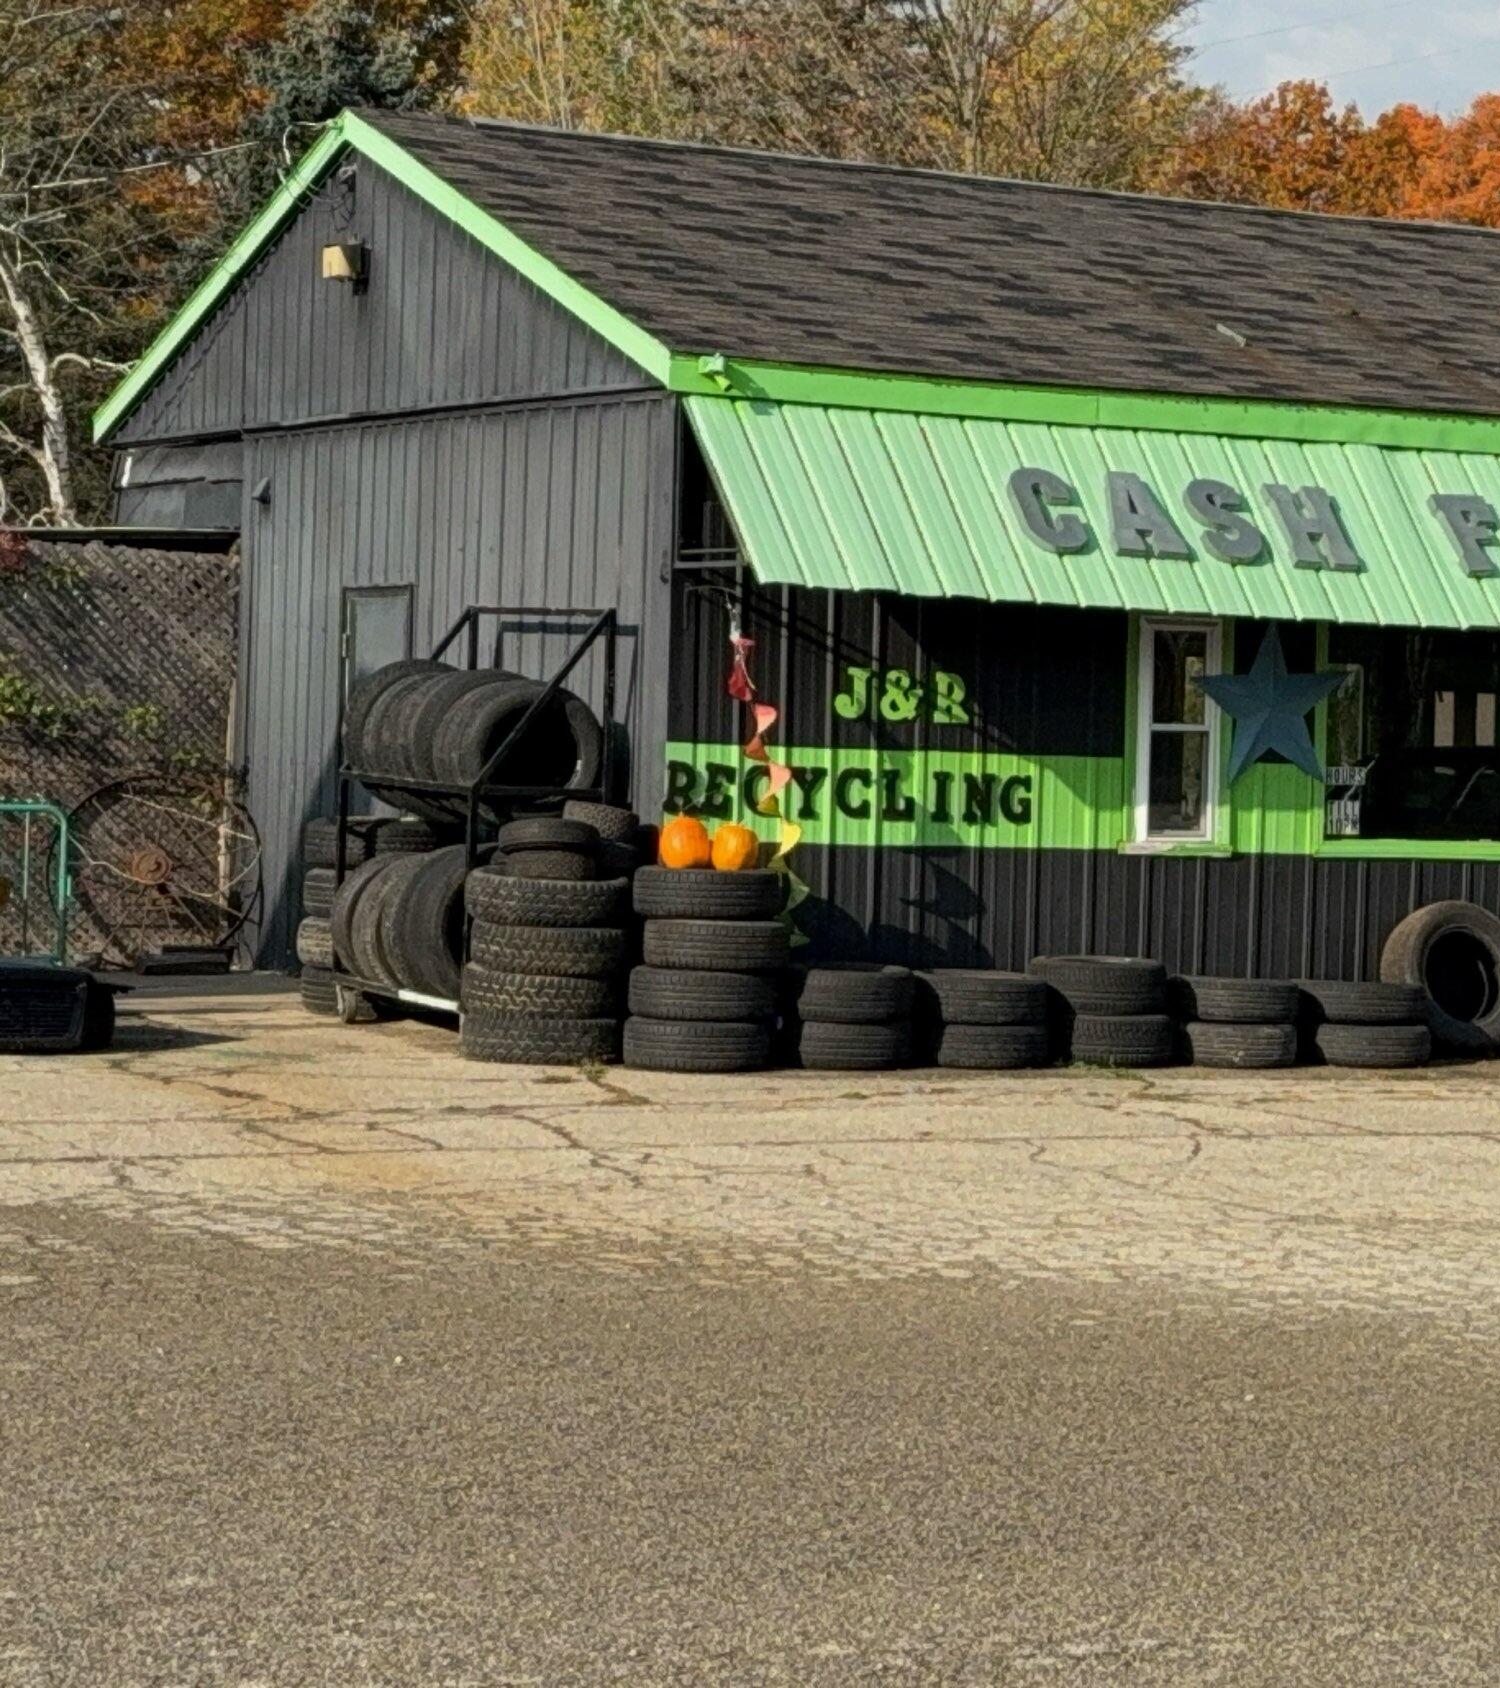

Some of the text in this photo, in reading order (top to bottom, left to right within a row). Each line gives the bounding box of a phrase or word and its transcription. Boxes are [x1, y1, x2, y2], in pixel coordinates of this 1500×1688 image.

[1007, 466, 1362, 573] CASH
[834, 666, 970, 724] J&R
[662, 759, 1033, 826] RECYCLING
